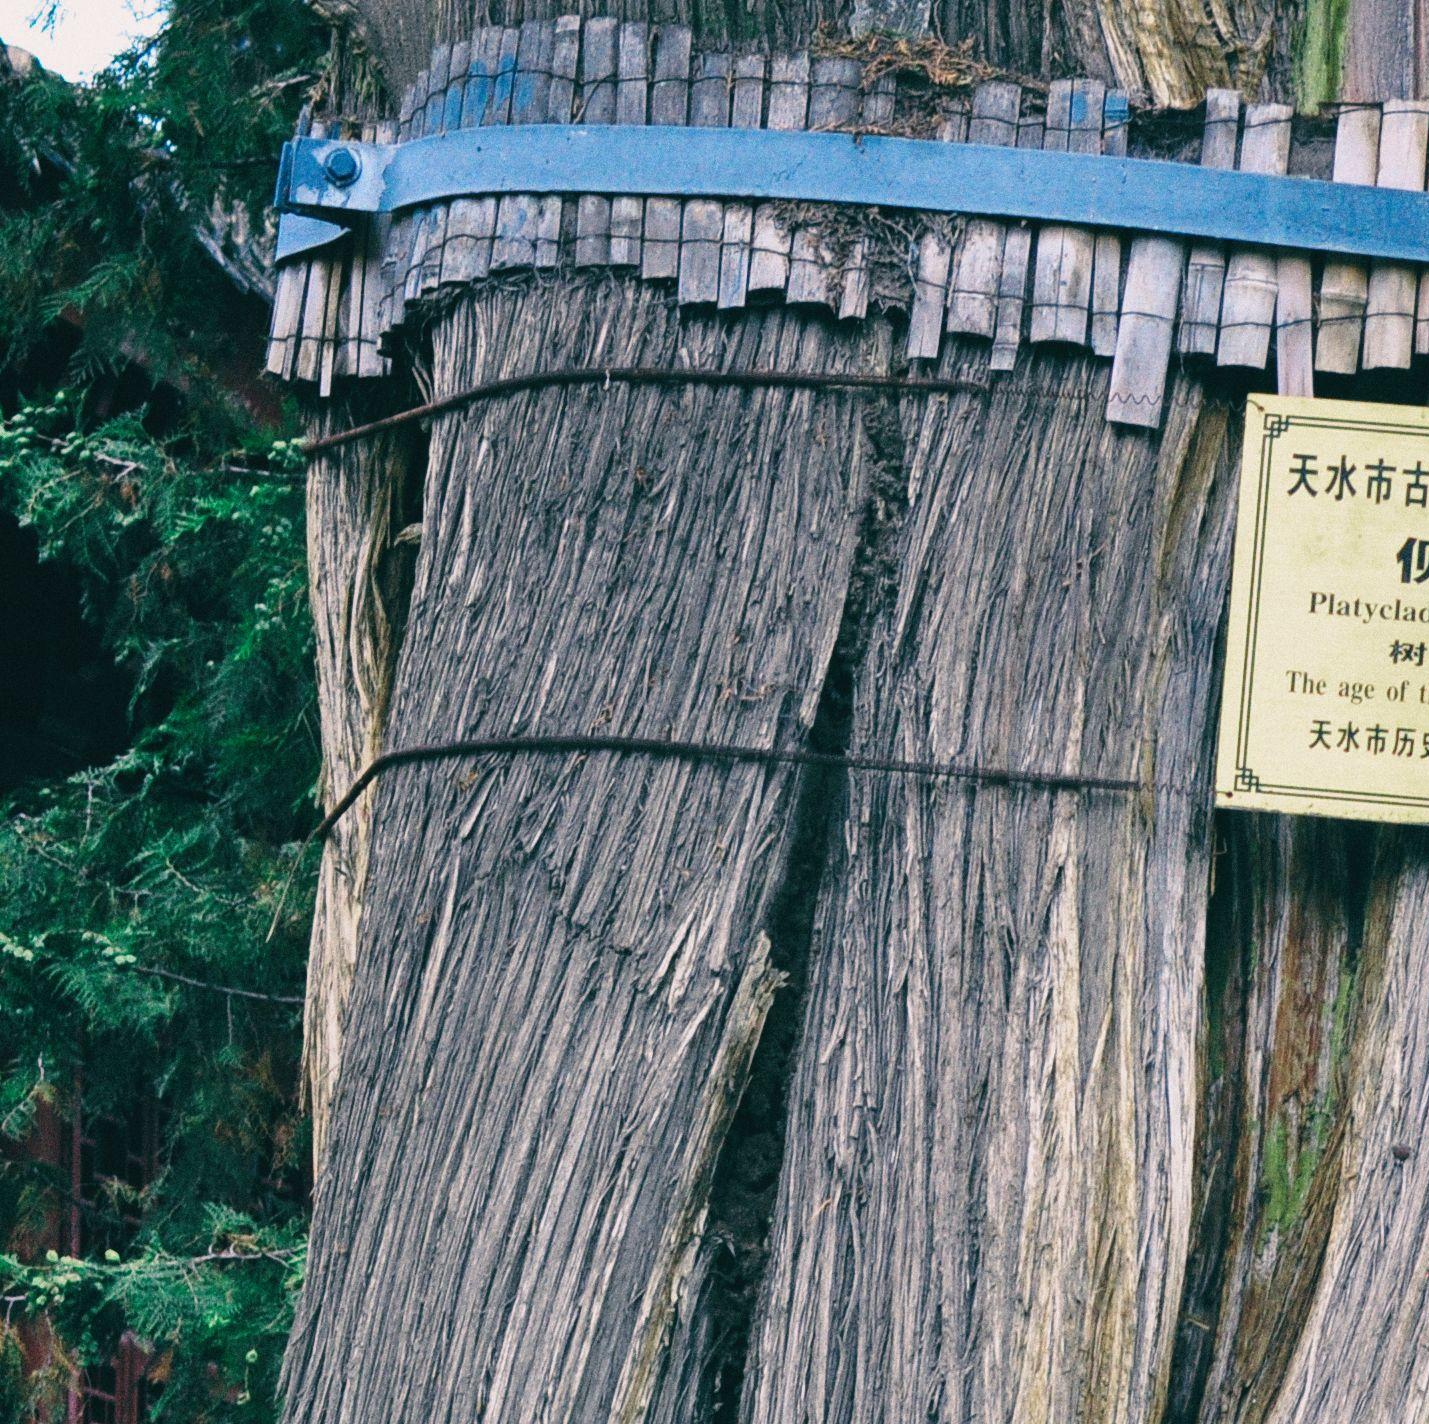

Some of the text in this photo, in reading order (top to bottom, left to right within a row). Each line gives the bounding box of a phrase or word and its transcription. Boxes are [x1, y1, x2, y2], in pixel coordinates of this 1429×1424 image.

[1286, 670, 1327, 695] The
[1338, 681, 1375, 704] age
[1386, 680, 1410, 702] of
